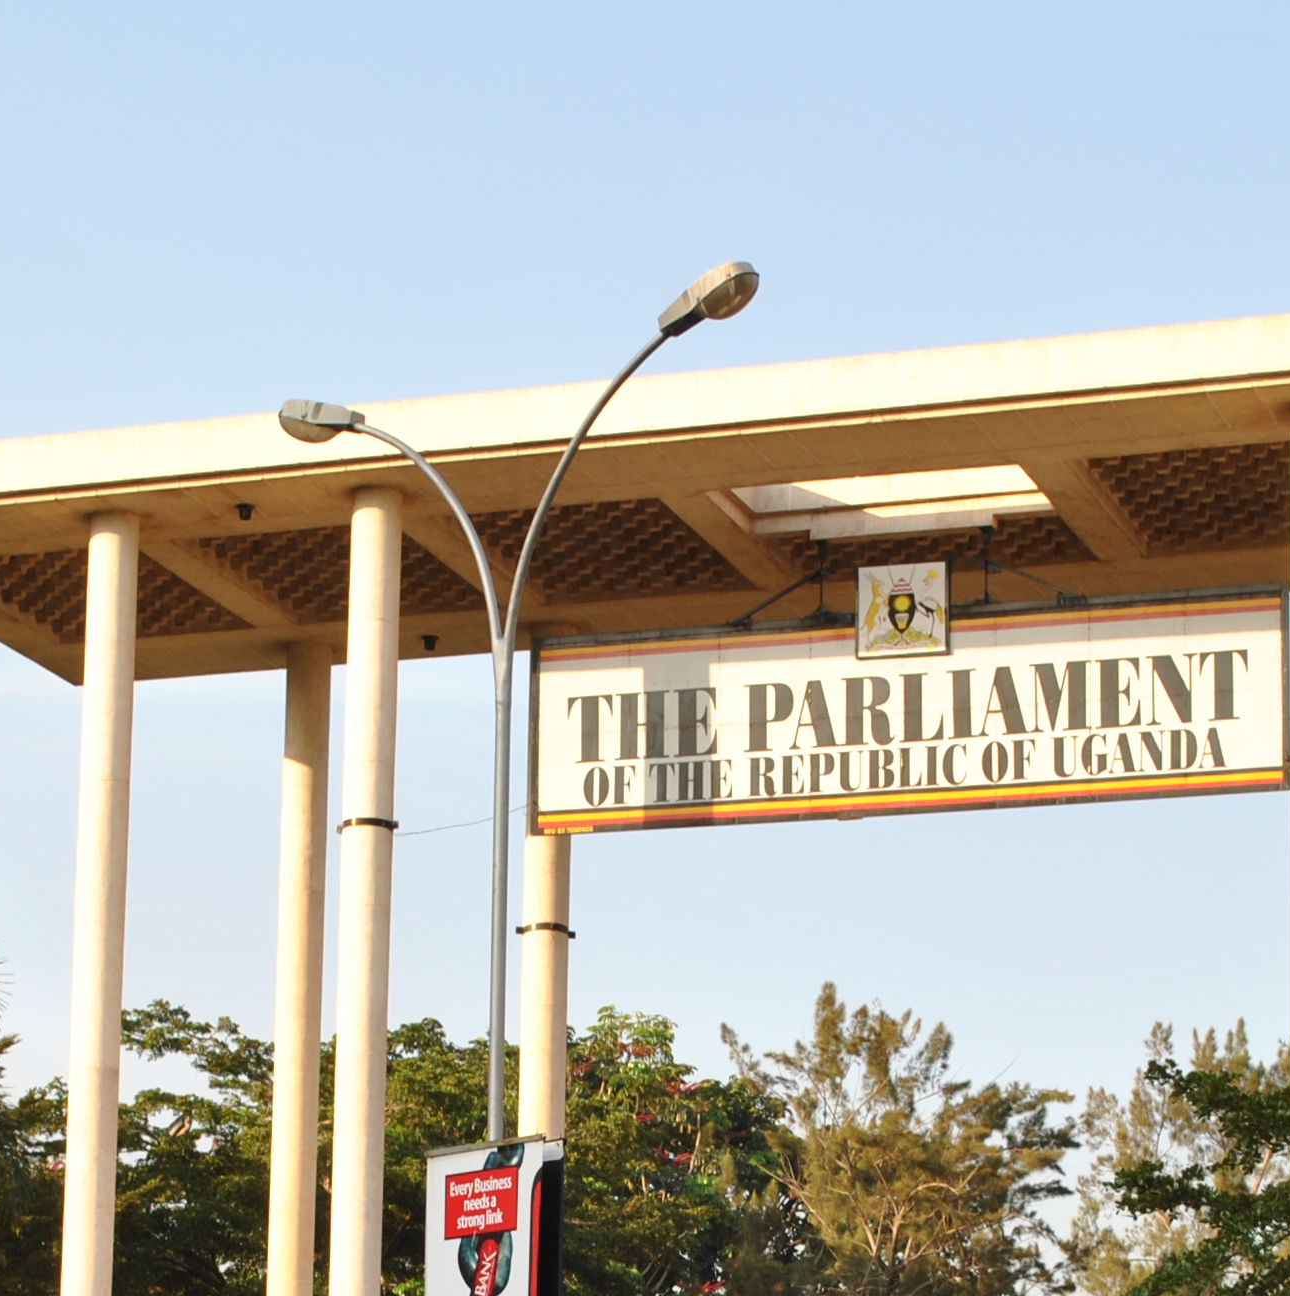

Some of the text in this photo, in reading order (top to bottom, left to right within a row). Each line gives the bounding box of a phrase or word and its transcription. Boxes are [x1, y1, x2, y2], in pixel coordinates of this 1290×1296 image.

[567, 649, 1249, 763] THE PARLIAMENT
[582, 727, 1228, 807] OF THE REPUBLIC OF UGANDA
[450, 1175, 513, 1198] Every Business
[463, 1193, 497, 1212] needs a
[457, 1207, 504, 1230] strong link
